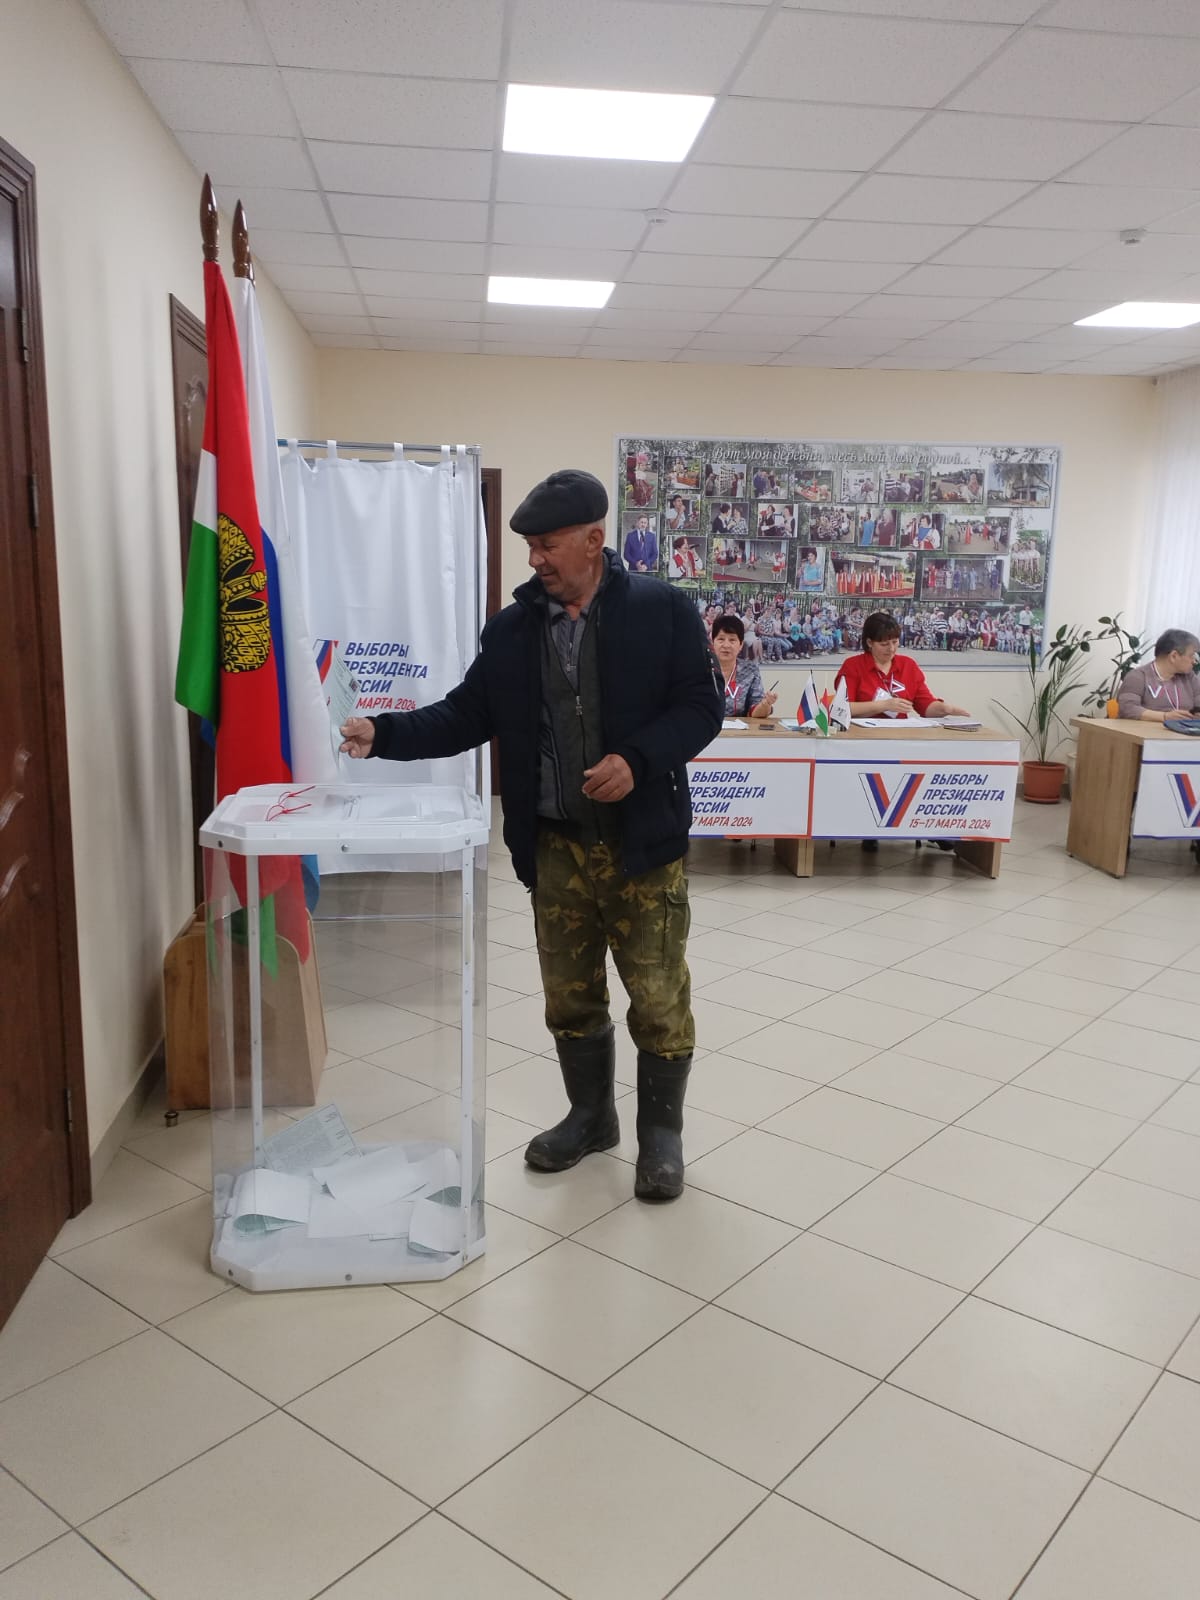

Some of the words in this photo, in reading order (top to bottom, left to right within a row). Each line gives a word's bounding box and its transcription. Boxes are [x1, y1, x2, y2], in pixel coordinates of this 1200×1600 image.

[713, 447, 741, 461] Вот
[344, 642, 410, 658] ВЫБОРЫ
[355, 697, 394, 710] МАРТА
[394, 698, 417, 711] 2024
[691, 771, 751, 783] ВЫБОРЫ
[930, 773, 989, 786] ВЫБОРЫ
[922, 788, 1006, 803] ПРЕЗИДЕНТА
[691, 801, 731, 814] ССИИ
[914, 803, 968, 816] РОССИИ
[698, 816, 730, 827] МАРТА
[730, 816, 753, 827] 2024
[934, 818, 968, 829] МАРТА
[968, 819, 992, 830] 2024
